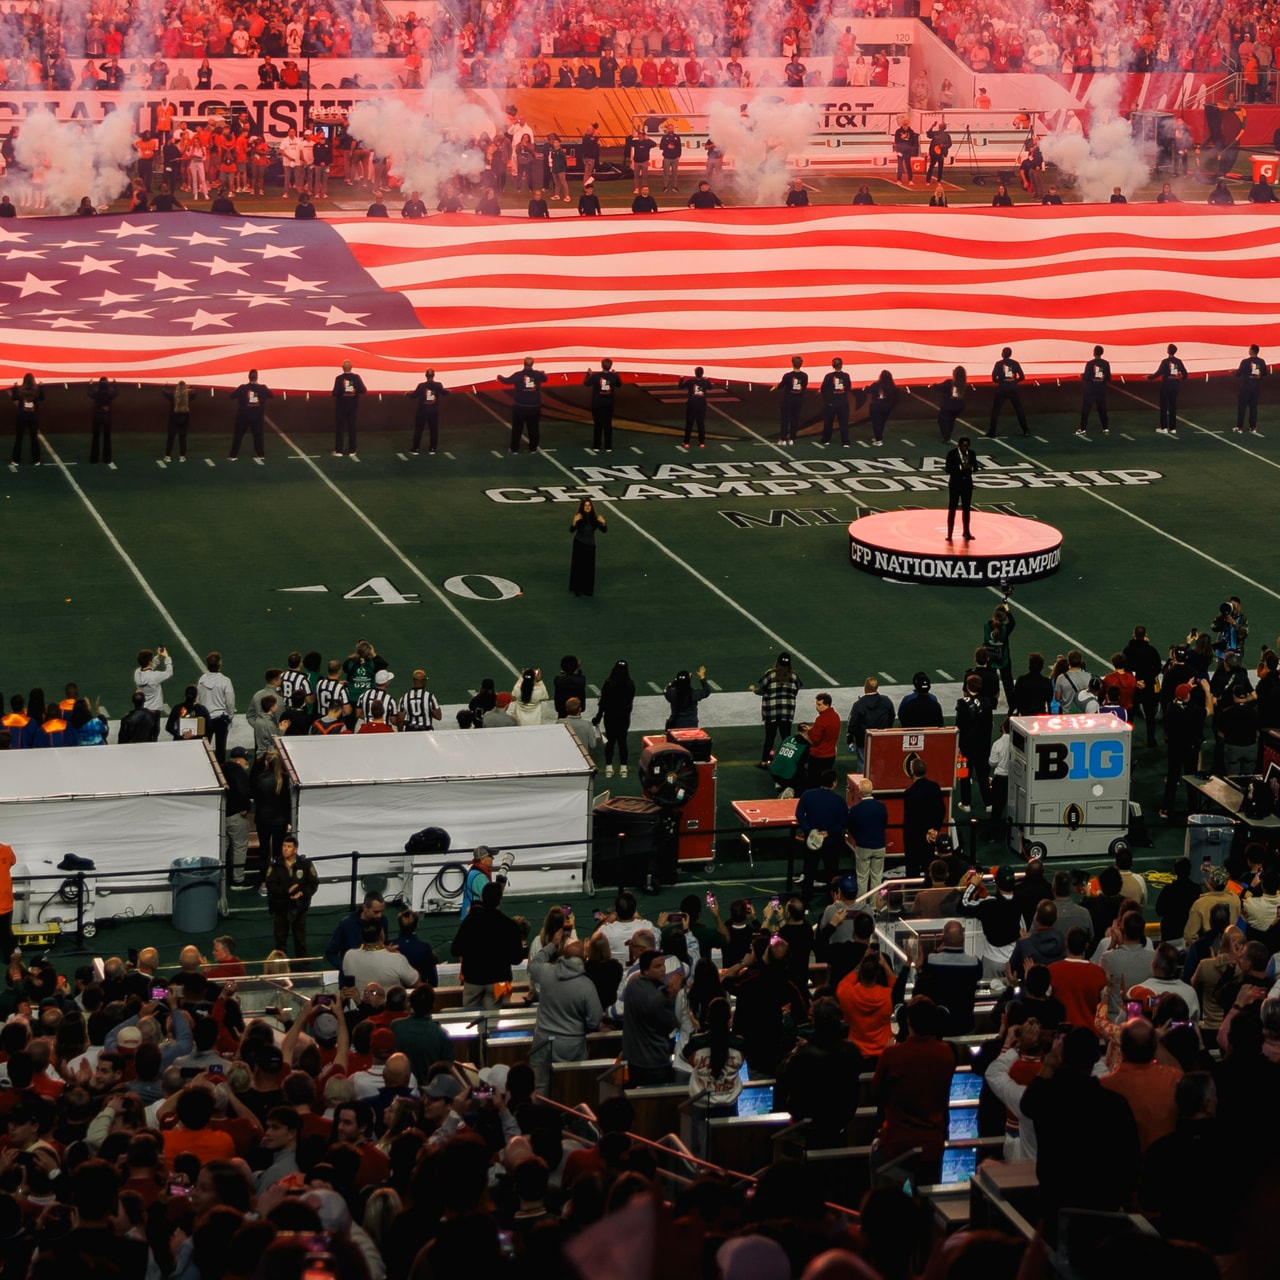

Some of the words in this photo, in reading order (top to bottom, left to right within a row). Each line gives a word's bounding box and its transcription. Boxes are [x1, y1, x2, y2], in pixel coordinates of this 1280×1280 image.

[895, 33, 910, 42] 120
[815, 102, 874, 128] T&T
[1261, 164, 1273, 178] G
[572, 455, 1035, 483] NATIONAL
[483, 467, 1165, 504] CHAMPIONSHIP
[851, 541, 872, 566] CFP
[874, 551, 983, 579] NATIONAL
[342, 573, 523, 606] 40
[283, 681, 293, 698] B
[410, 699, 422, 716] U
